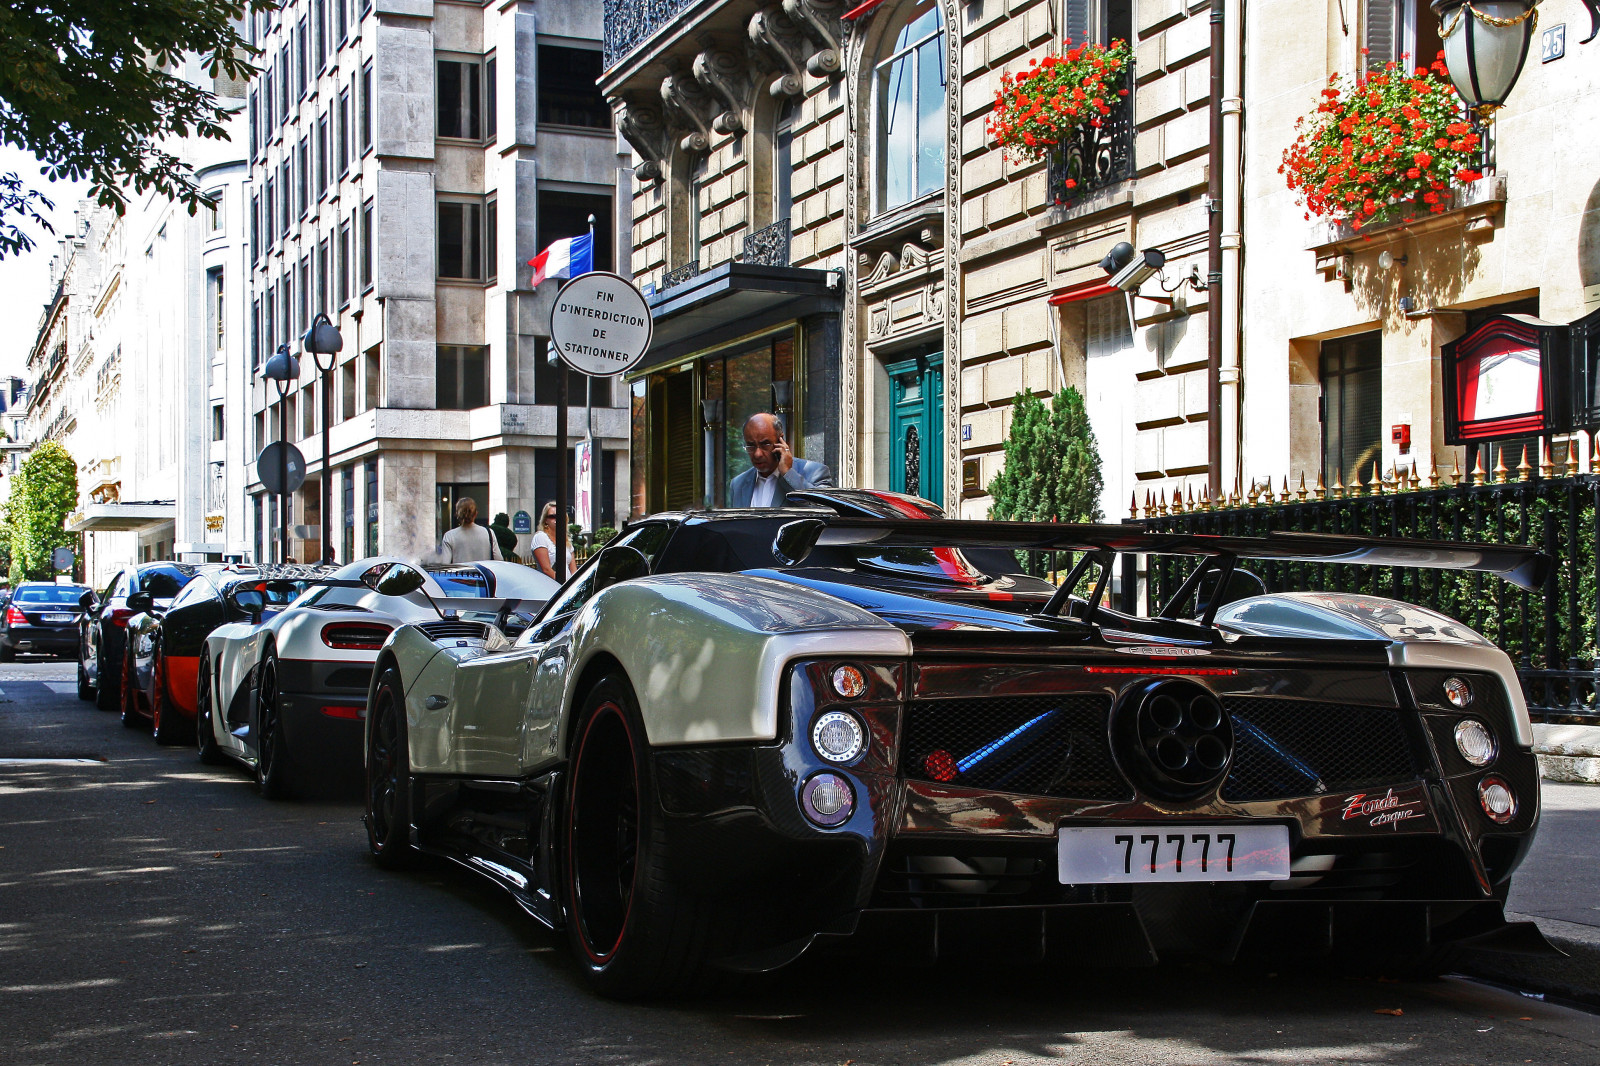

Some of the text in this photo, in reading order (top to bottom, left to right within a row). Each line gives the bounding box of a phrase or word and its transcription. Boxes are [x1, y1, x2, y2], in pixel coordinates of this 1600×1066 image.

[1542, 29, 1562, 58] 25
[596, 291, 614, 303] FIN
[560, 303, 645, 327] D'INTERDICTION
[592, 328, 607, 339] DE
[564, 342, 629, 362] STATIONNER
[962, 425, 971, 440] 21
[1128, 647, 1199, 656] PAGANI
[1341, 787, 1420, 821] Zonda
[1114, 834, 1236, 874] 77777
